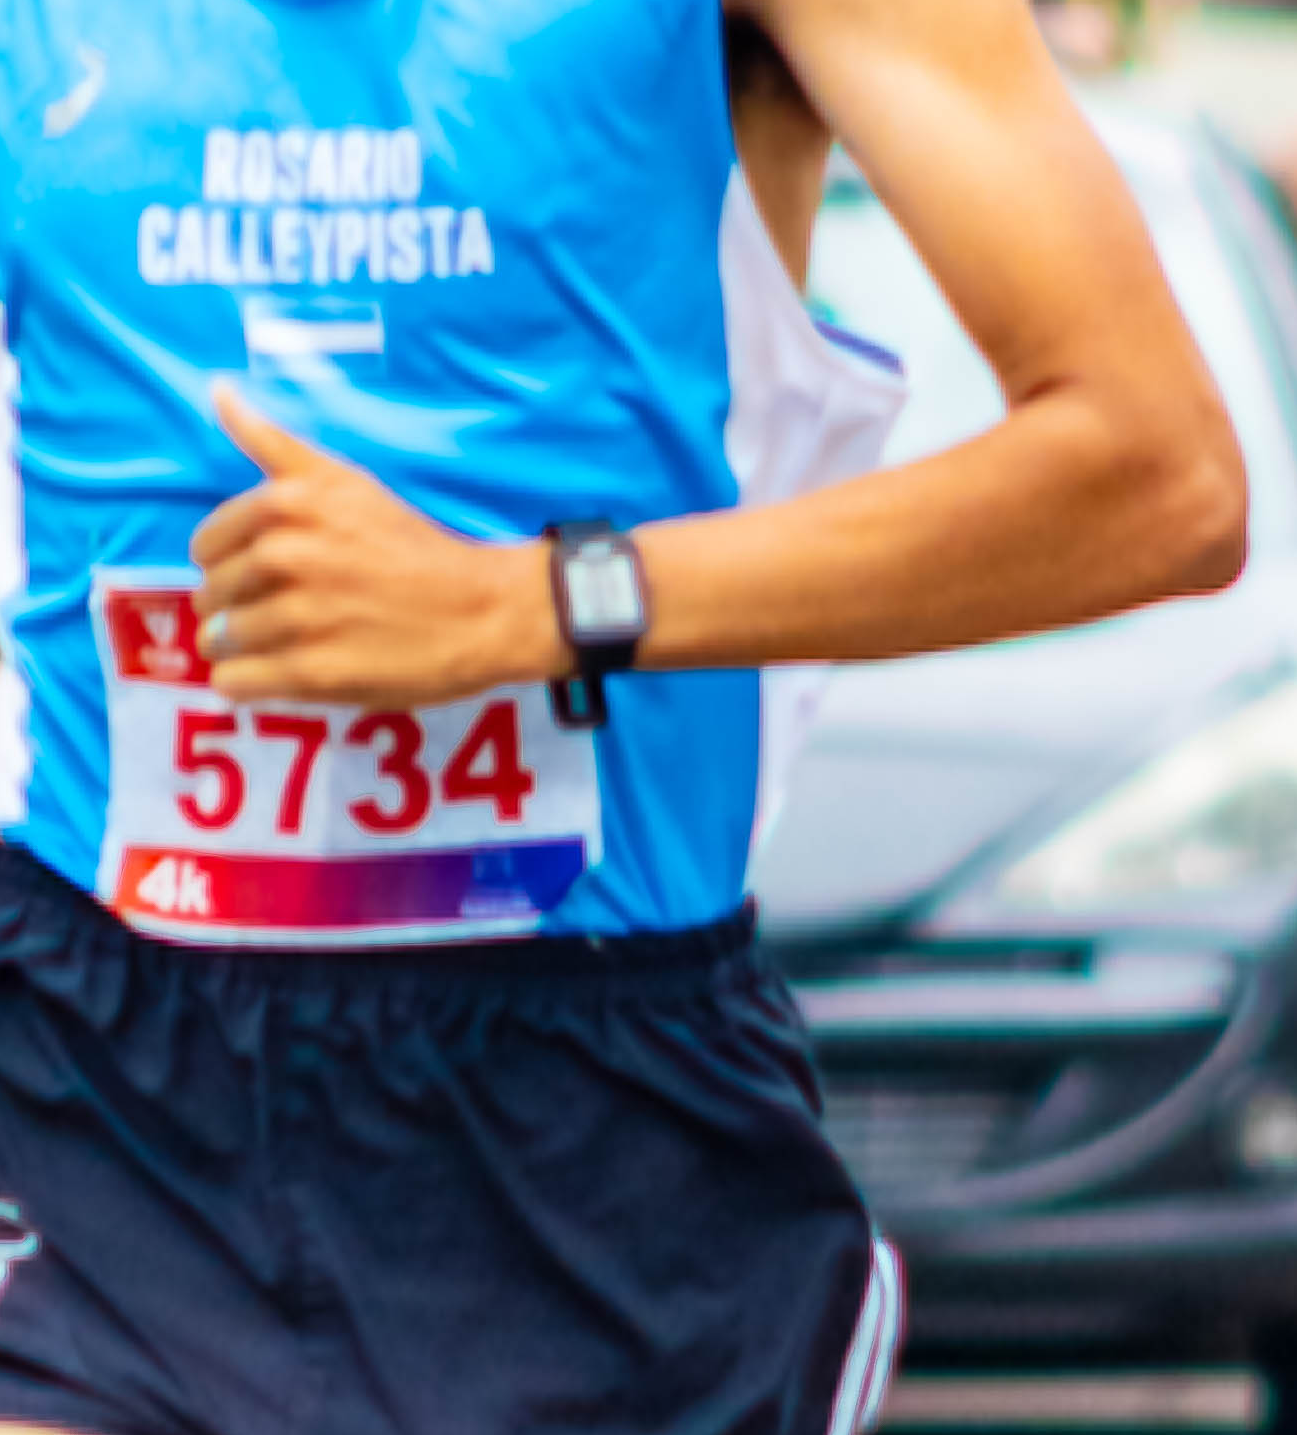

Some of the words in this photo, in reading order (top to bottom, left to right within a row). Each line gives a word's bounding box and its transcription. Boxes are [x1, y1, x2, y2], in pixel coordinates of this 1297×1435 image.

[204, 126, 423, 203] ROSARIO
[137, 202, 495, 286] CALLEYPISTA
[172, 697, 536, 836] 5734
